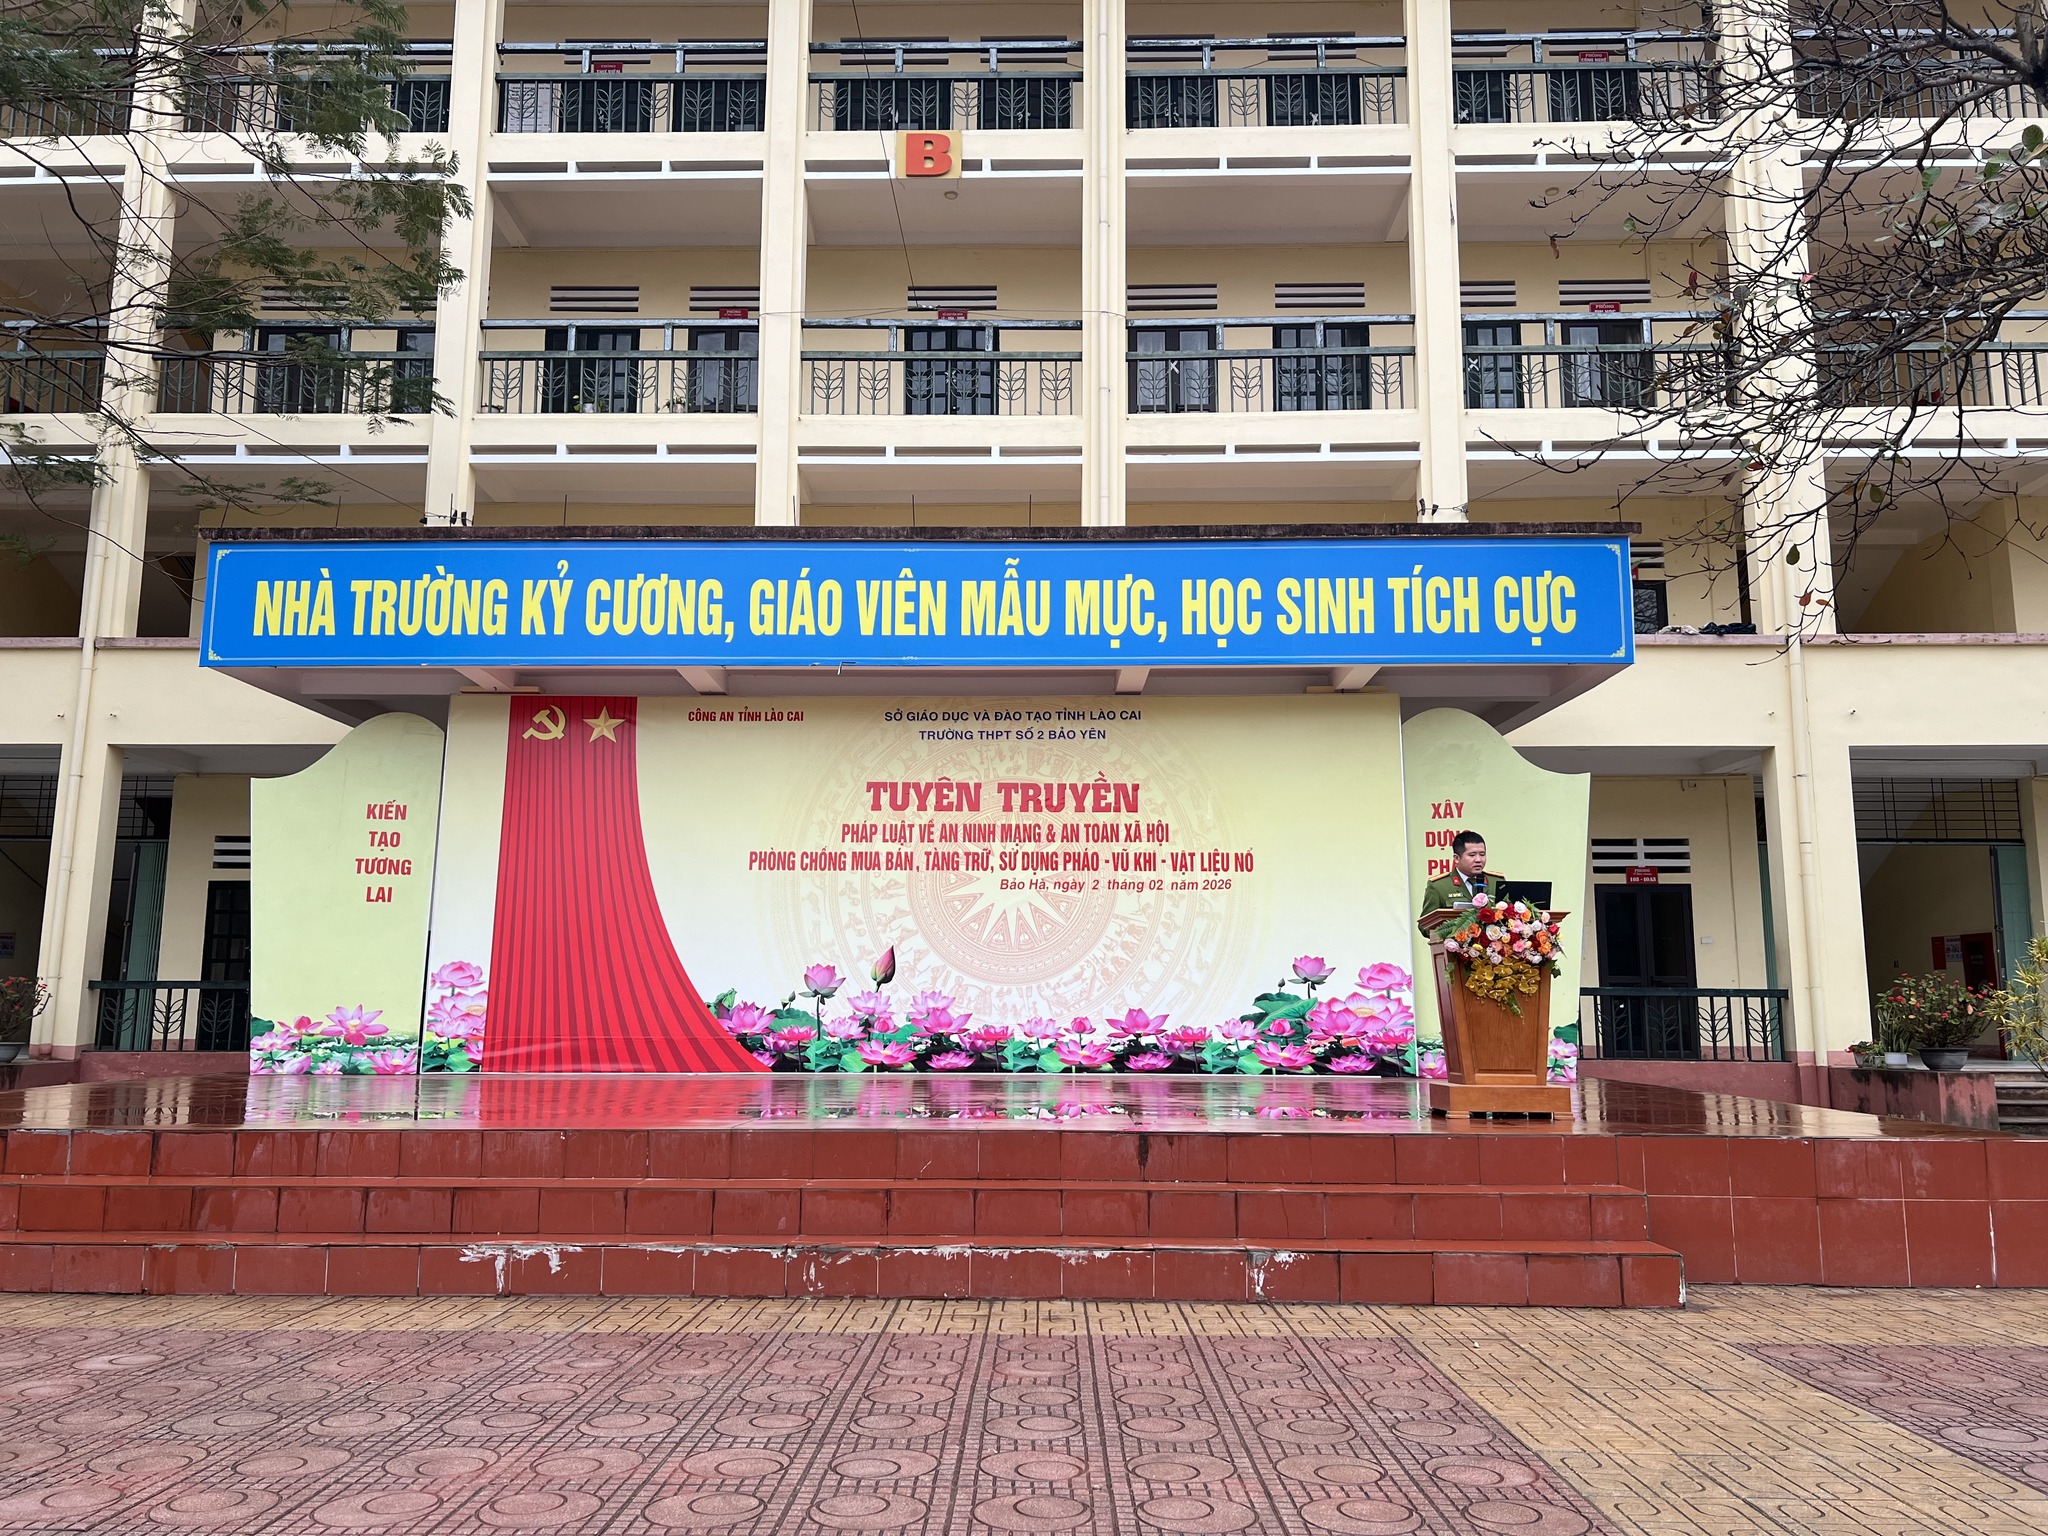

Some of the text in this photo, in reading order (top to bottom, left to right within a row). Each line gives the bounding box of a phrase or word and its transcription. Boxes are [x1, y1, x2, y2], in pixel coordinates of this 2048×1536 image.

[906, 132, 952, 176] B
[253, 558, 1577, 648] NHÀ TRƯỜNG KỶ CƯƠNG, GIÁO VIÊN MẪU MỰC, HỌC SINH TÍCH CỰC
[688, 706, 804, 722] CÔNG AN TỈNH LÀO CAI
[884, 708, 1142, 724] SỞ GIÁO DỤC VÀ ĐÀO TẠO TỈNH LÀO CAI
[918, 727, 1106, 740] TRƯỜNG THPT SỐ 2 BẢO YÊN
[866, 771, 1140, 813] TUYÊN TRUYỀN
[366, 800, 408, 820] KIẾN
[1431, 799, 1464, 819] XÂY
[369, 831, 401, 852] TẠO
[842, 818, 1170, 846] PHÁP LUẬT VỀ AN NINH MẠNG & AN TOÀN XÃ HỘI
[1425, 829, 1470, 850] DỰN
[356, 858, 412, 875] TƯƠNG
[749, 847, 796, 871] PHÒNG
[800, 846, 847, 871] CHỐNG
[851, 852, 881, 871] MUA
[924, 847, 960, 871] TÀNG
[964, 848, 994, 873] TRỮ,
[999, 849, 1018, 871] SỬ
[1022, 852, 1059, 875] DỤNG
[1064, 848, 1100, 871] PHÁO
[1112, 848, 1130, 871] VŨ
[1170, 850, 1196, 875] VẬT
[1200, 848, 1230, 876] LIỆU
[366, 886, 392, 902] LAI
[1000, 878, 1232, 893] Bảo Hà, ngày 2 tháng 02 năm 2026
